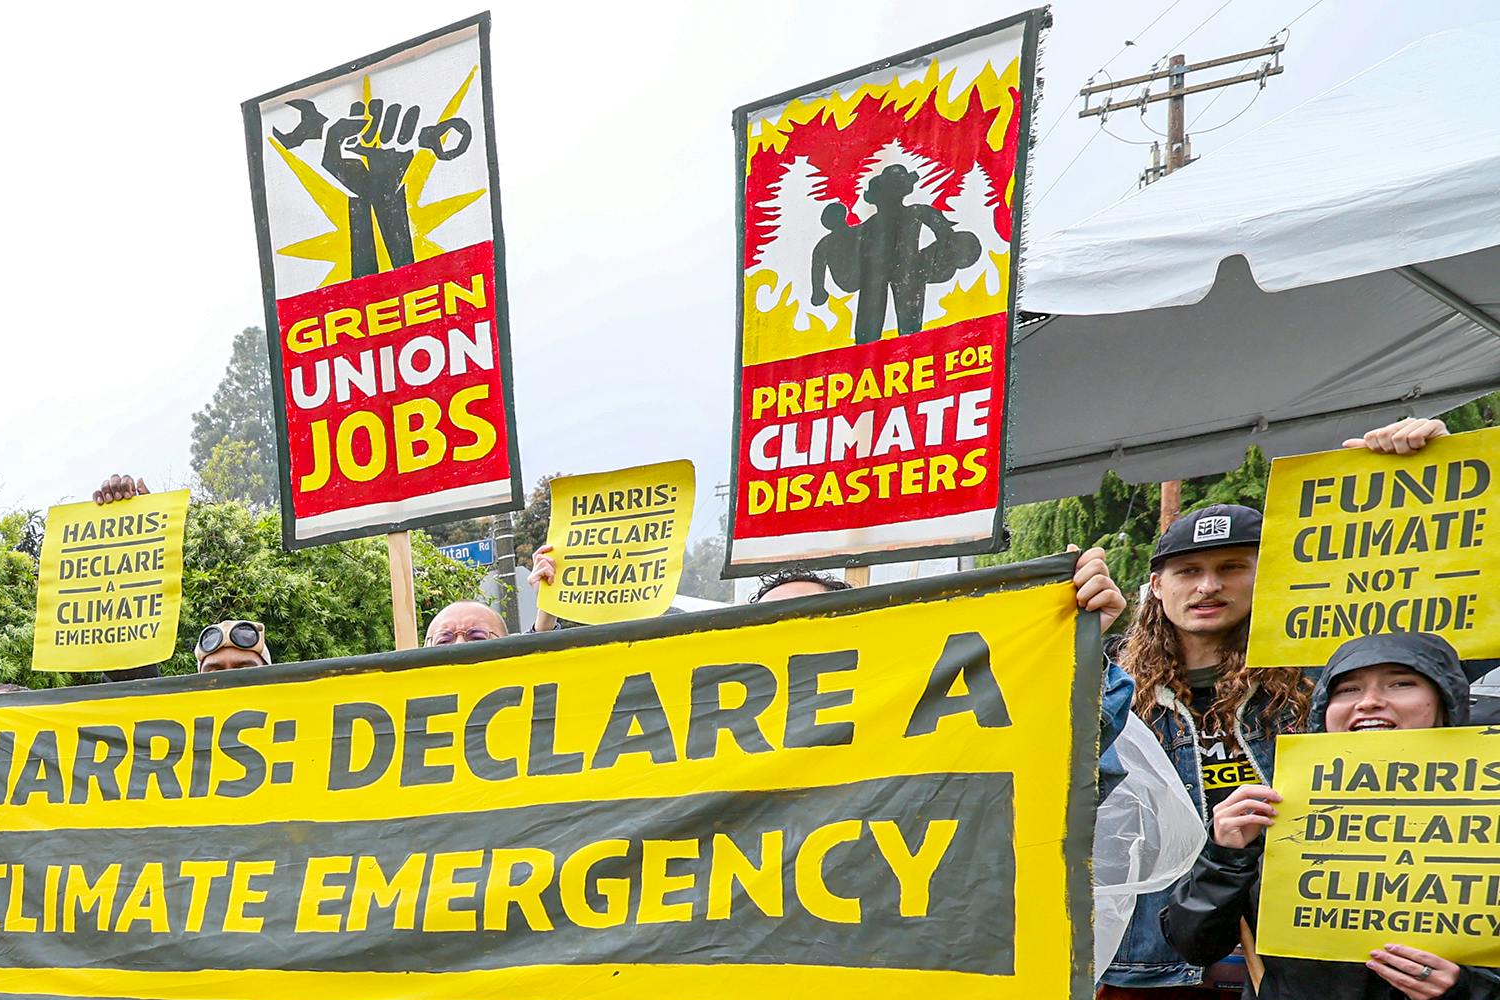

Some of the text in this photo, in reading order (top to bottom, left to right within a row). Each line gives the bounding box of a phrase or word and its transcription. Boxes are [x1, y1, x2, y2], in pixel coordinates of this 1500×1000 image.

[287, 274, 487, 354] GREEN
[291, 320, 494, 410] UNION
[752, 345, 992, 419] PREPARE FOR
[301, 385, 497, 493] JOBS
[749, 388, 992, 471] CLIMATE
[748, 448, 988, 516] DISASTERS
[1299, 459, 1491, 518] FUND
[572, 484, 677, 516] HARRIS:
[63, 512, 168, 543] HARRIS:
[567, 520, 674, 547] DECLARE
[1293, 508, 1486, 562] CLIMATE
[478, 542, 490, 552] Rd
[612, 548, 622, 559] A
[60, 548, 164, 580] DECLARE
[562, 559, 667, 586] CLIMATE
[1346, 567, 1419, 593] NOT
[106, 580, 115, 593] A
[559, 584, 663, 604] EMERGENCY
[57, 593, 163, 624] CLIMATE
[1285, 594, 1477, 639] GENOCIDE
[55, 622, 160, 646] EMERGENCY
[327, 649, 858, 792] DECLARE
[904, 631, 1012, 738] A
[1305, 814, 1500, 844] DECLAR
[1395, 849, 1415, 865] A
[295, 819, 959, 934] EMERGENCY
